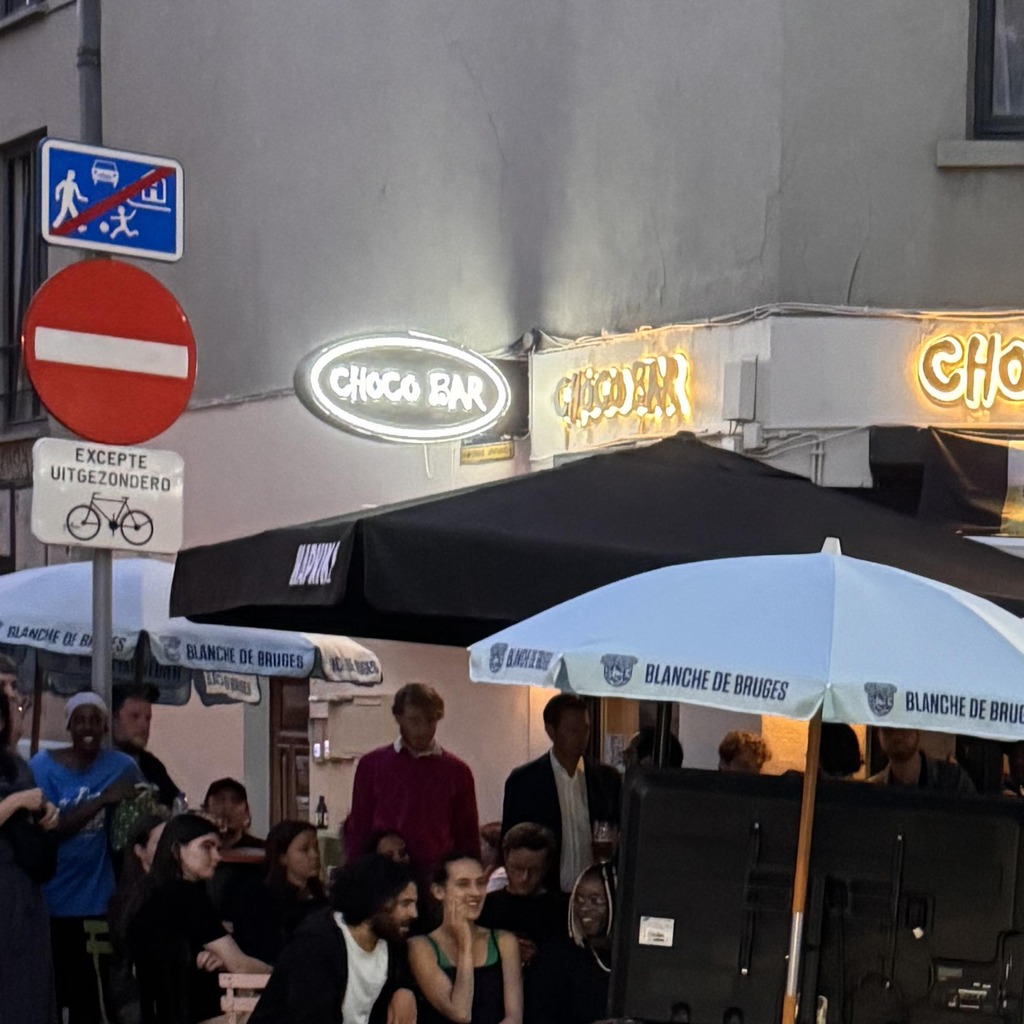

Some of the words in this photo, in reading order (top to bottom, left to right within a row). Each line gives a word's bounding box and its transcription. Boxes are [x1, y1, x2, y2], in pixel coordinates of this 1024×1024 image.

[330, 364, 421, 404] CHOCO
[428, 371, 487, 412] BAR
[75, 447, 147, 469] EXCEPTE
[51, 465, 171, 492] UITGEZONDERD
[7, 626, 60, 644] BLANCHE
[187, 643, 235, 664] BLANCHE
[240, 648, 253, 664] DE
[258, 651, 303, 669] BRUGES
[645, 663, 710, 691] BLANCHE
[711, 670, 730, 693] DE
[734, 674, 789, 701] BRUGES
[905, 691, 966, 718] BLANCHE
[969, 698, 987, 720] DE
